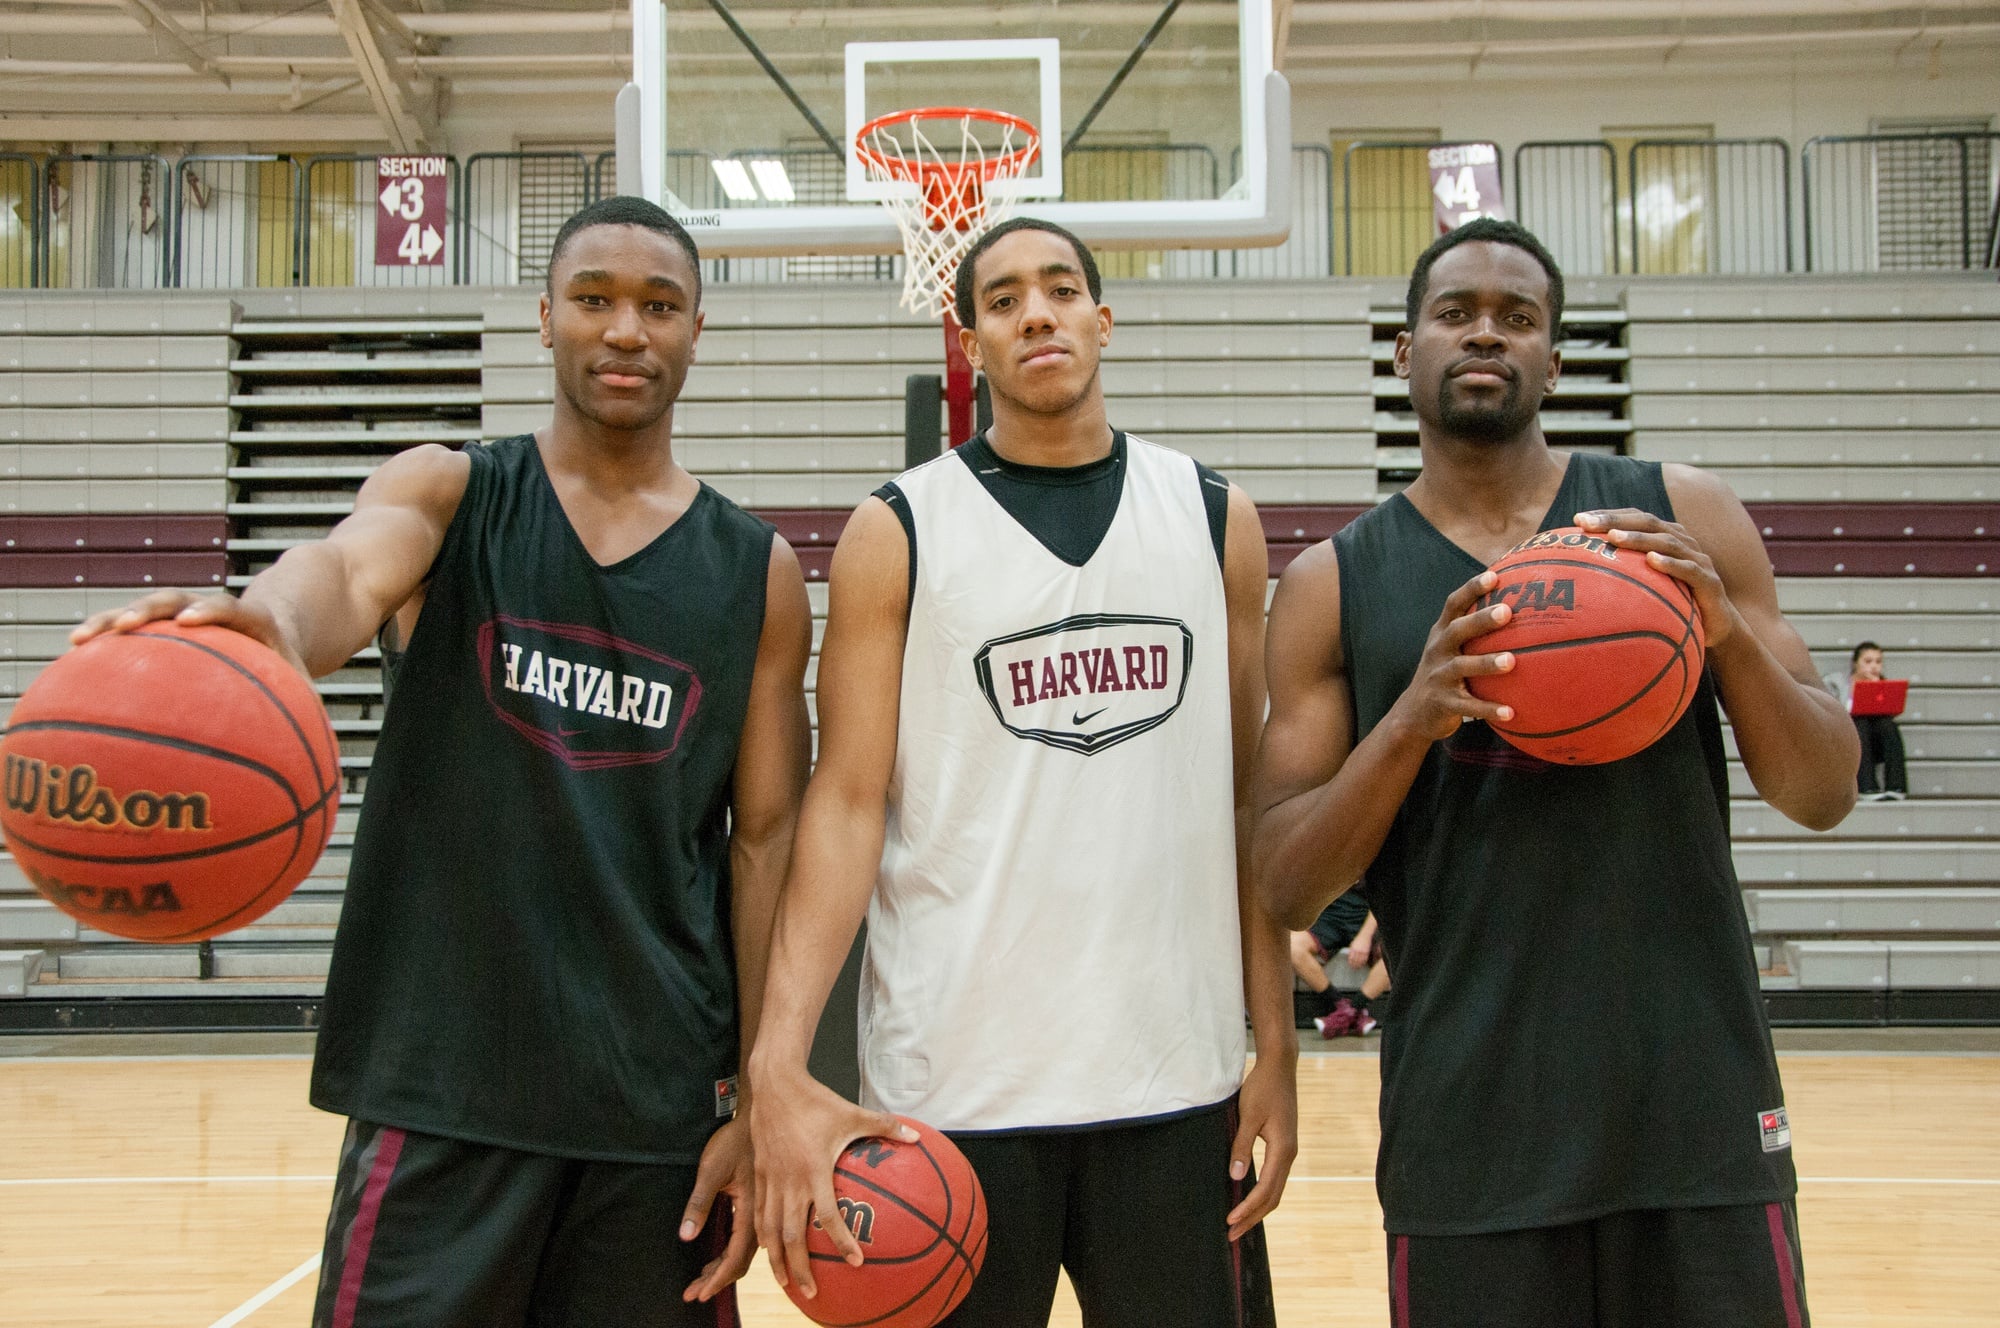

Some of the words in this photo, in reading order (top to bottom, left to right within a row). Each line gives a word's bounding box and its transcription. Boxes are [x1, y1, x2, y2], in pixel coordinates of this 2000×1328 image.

[380, 157, 446, 177] SECTION
[1428, 144, 1496, 169] SECTION
[400, 177, 424, 221] 3
[1455, 166, 1480, 210] 4
[678, 213, 720, 227] ALDING
[397, 223, 422, 265] 4
[502, 643, 672, 729] HARVARD
[1008, 644, 1168, 707] HARVARD
[6, 752, 214, 832] Wilson
